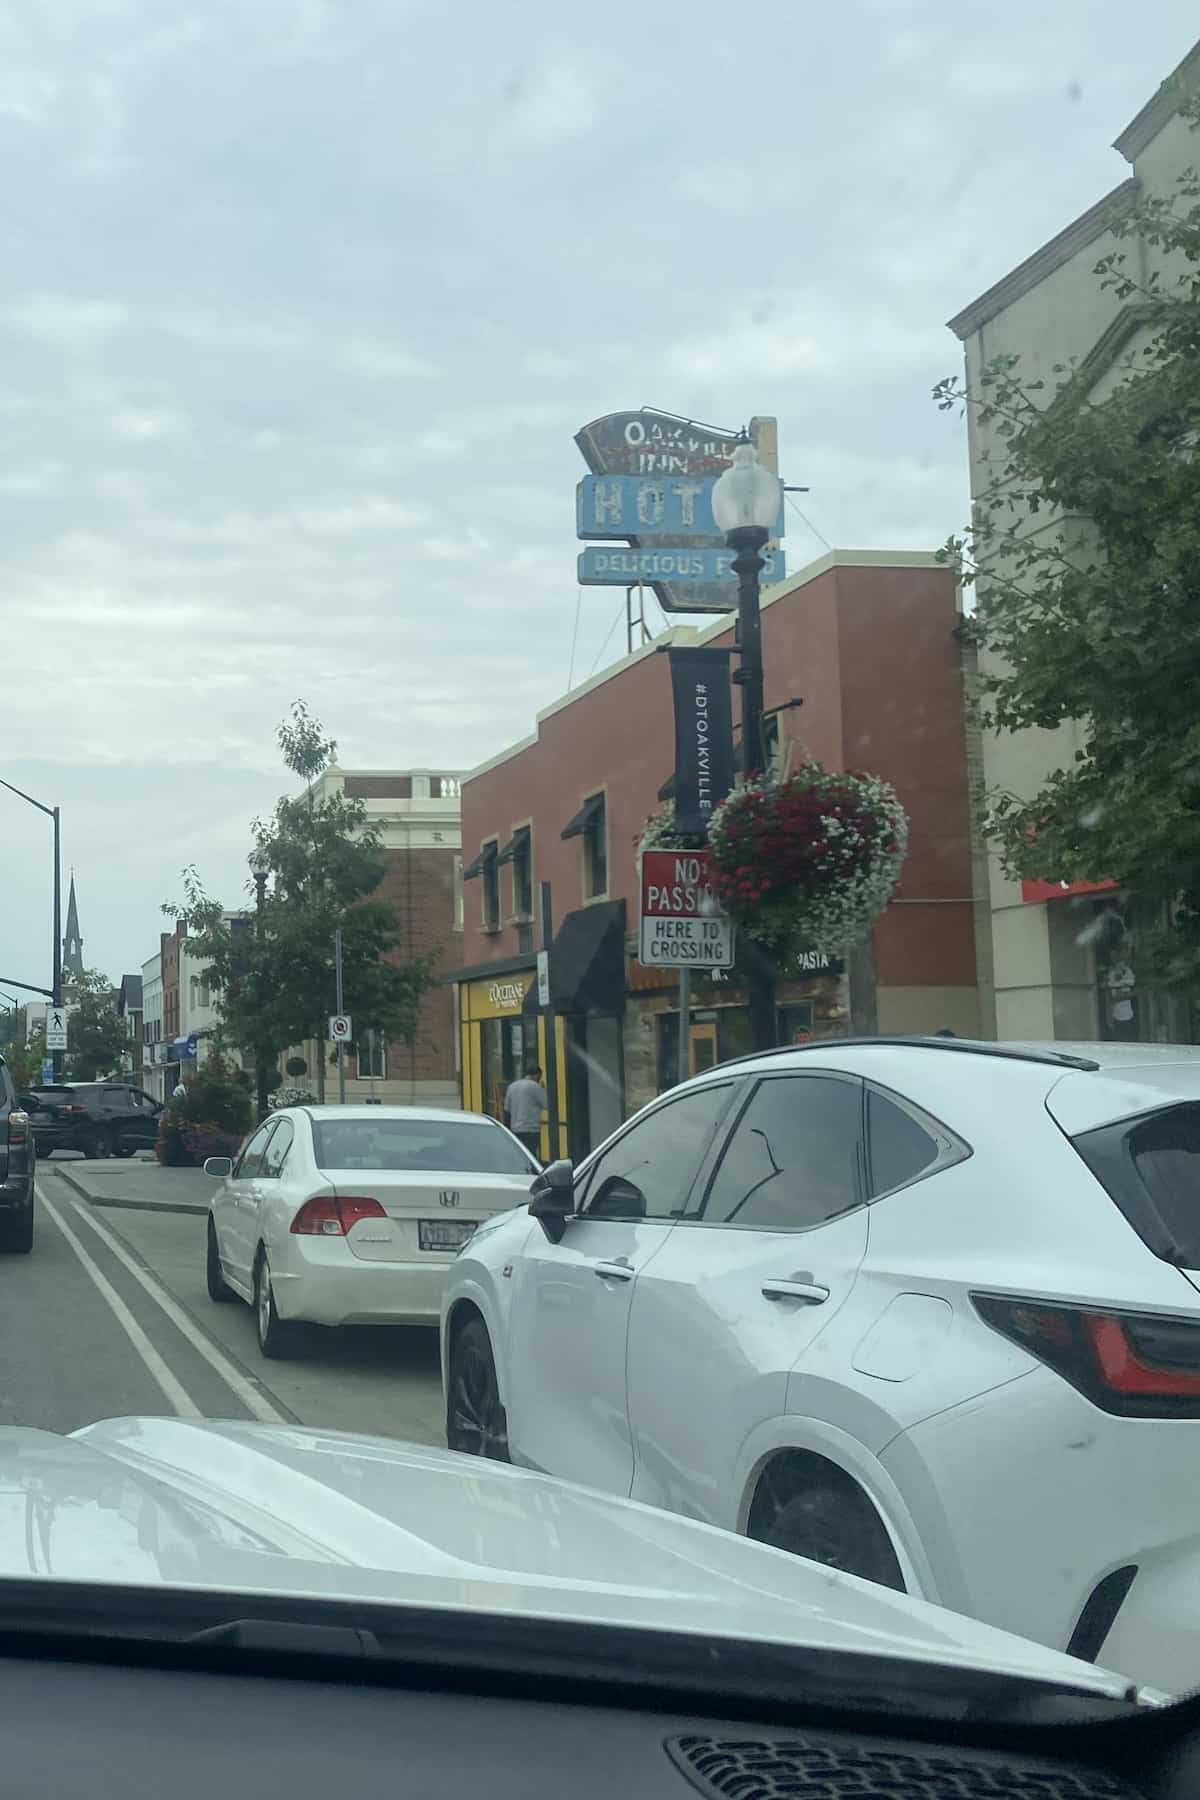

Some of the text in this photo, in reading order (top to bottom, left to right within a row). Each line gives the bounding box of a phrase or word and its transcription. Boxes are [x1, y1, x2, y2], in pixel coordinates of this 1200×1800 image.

[624, 420, 736, 461] OAKVILL
[593, 481, 705, 527] HOT
[594, 554, 776, 577] DELICIOUS FD
[696, 684, 712, 809] #DTOAKVILLE
[675, 858, 700, 884] NO
[656, 921, 718, 939] HERE TO
[651, 940, 723, 959] CROSSING
